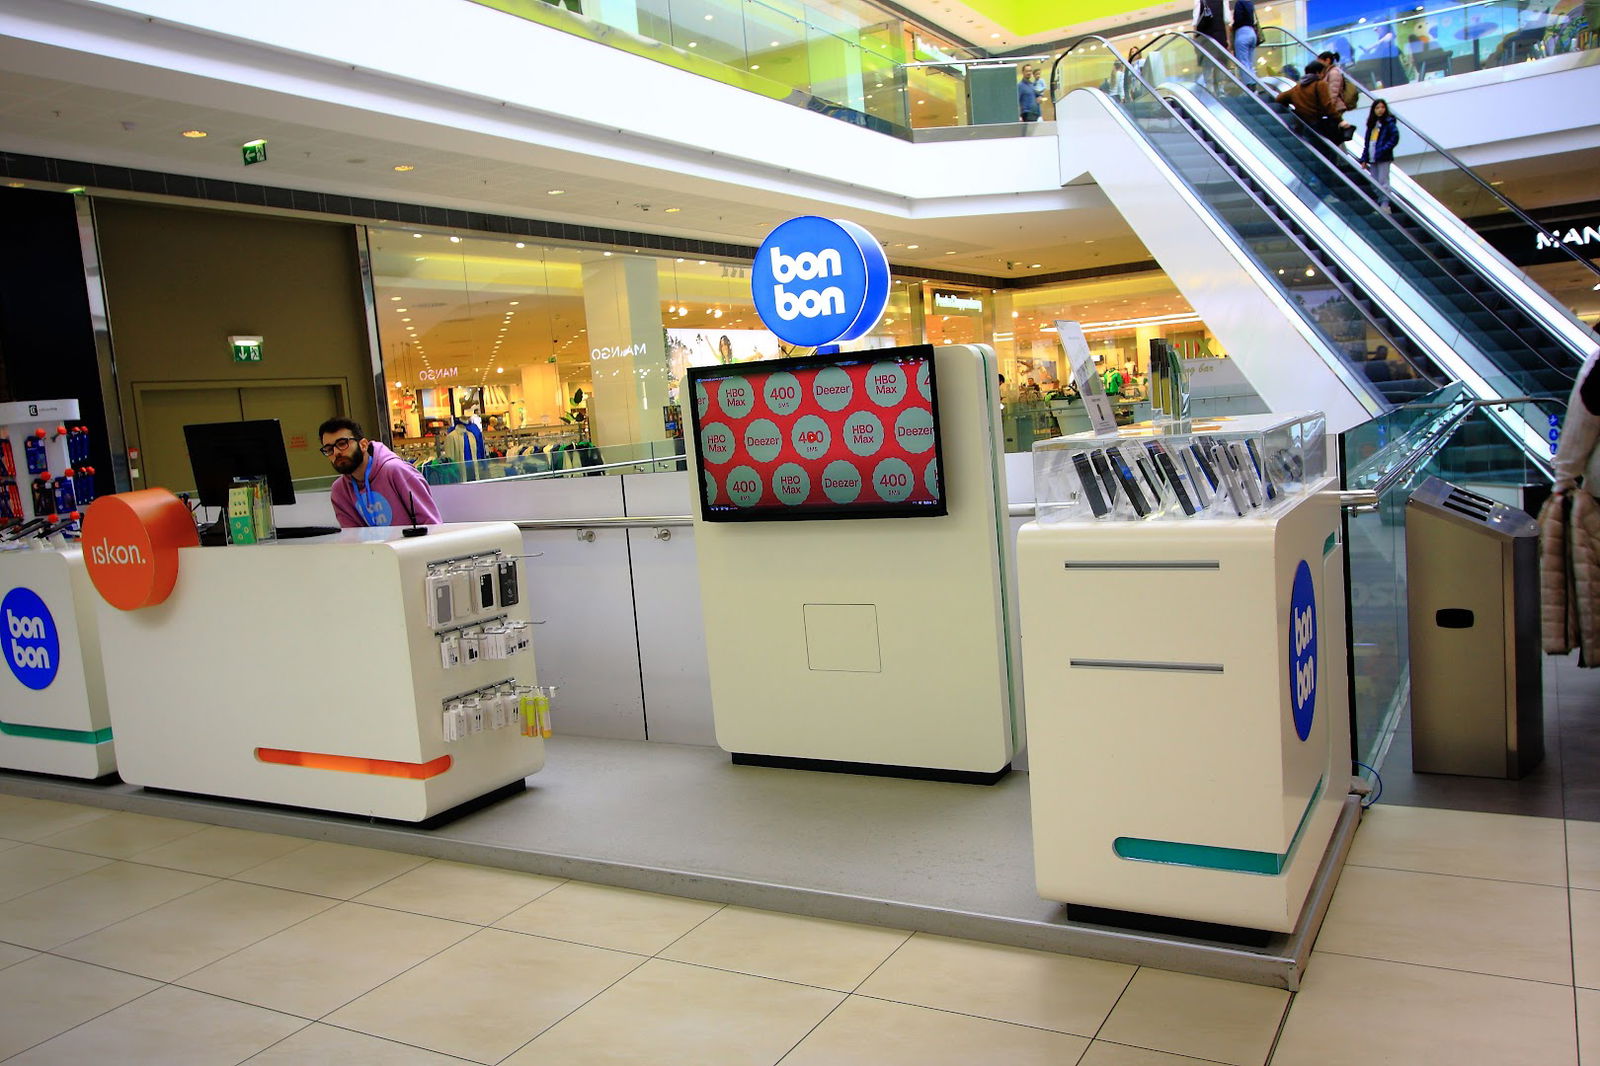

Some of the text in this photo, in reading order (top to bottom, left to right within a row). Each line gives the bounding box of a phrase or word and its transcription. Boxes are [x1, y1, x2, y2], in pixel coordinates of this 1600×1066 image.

[770, 246, 842, 284] bon
[774, 284, 846, 321] bon
[874, 374, 897, 385] HBO
[725, 388, 745, 398] HBO
[770, 386, 795, 400] 400
[816, 385, 850, 396] Deezer
[875, 385, 898, 395] Max
[727, 398, 746, 407] Max
[852, 423, 874, 435] HBO
[898, 426, 934, 437] Deezer
[707, 434, 726, 444] HBO
[747, 436, 780, 447] Deezer
[853, 434, 874, 444] Max
[708, 444, 727, 453] Max
[780, 475, 801, 485] HBO
[825, 477, 859, 488] Deezer
[880, 474, 907, 488] 400
[733, 480, 756, 493] 400
[781, 485, 801, 495] Max
[6, 608, 46, 639] bon
[1295, 605, 1313, 657] bon
[11, 638, 51, 669] bon
[1296, 655, 1315, 710] bon
